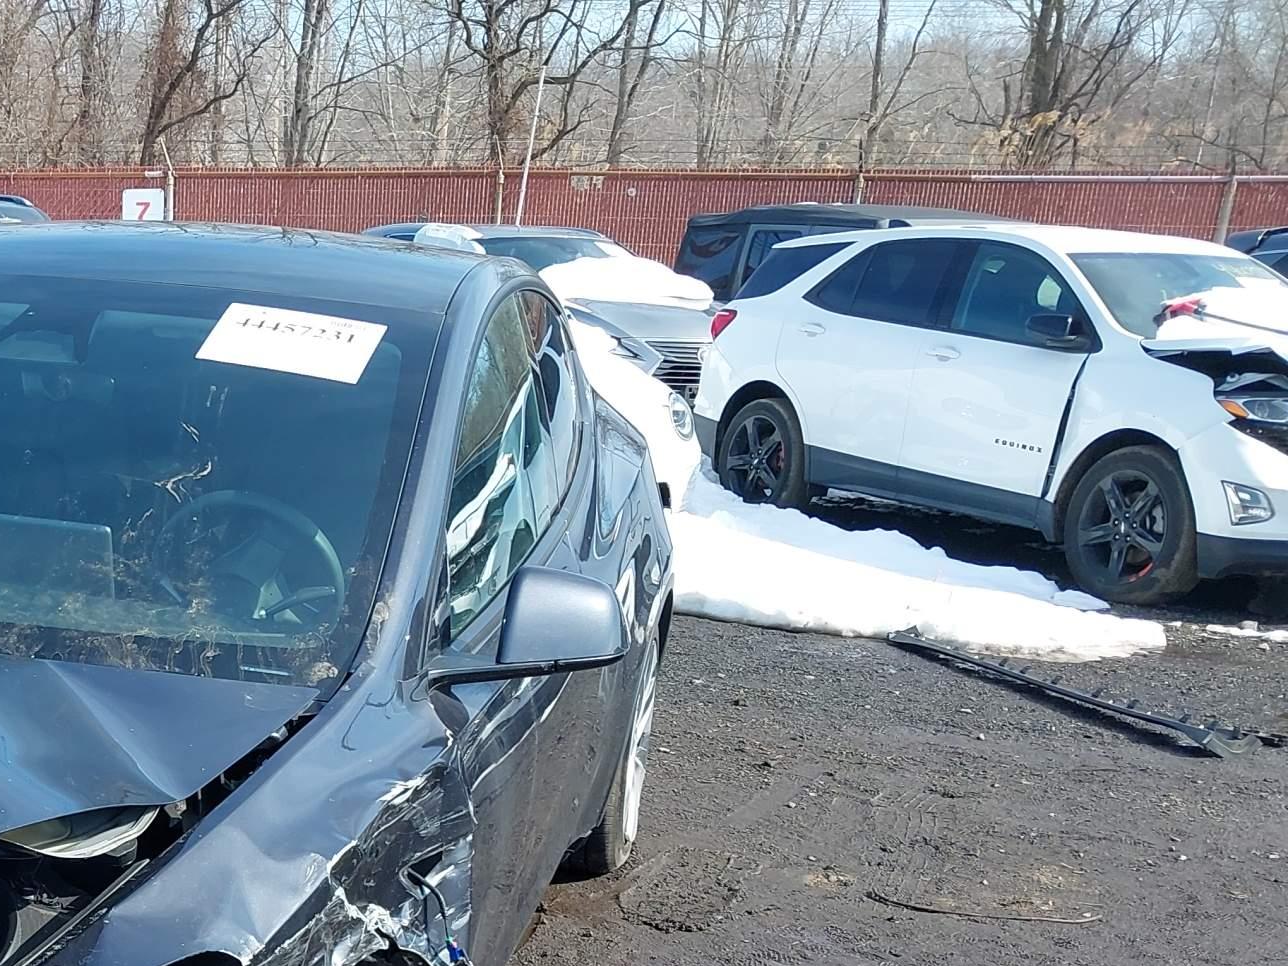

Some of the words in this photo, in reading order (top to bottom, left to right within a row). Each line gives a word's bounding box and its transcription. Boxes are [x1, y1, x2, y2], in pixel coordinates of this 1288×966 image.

[136, 201, 151, 221] 7
[235, 318, 356, 344] 44457231
[994, 438, 1042, 453] EQUINOX
